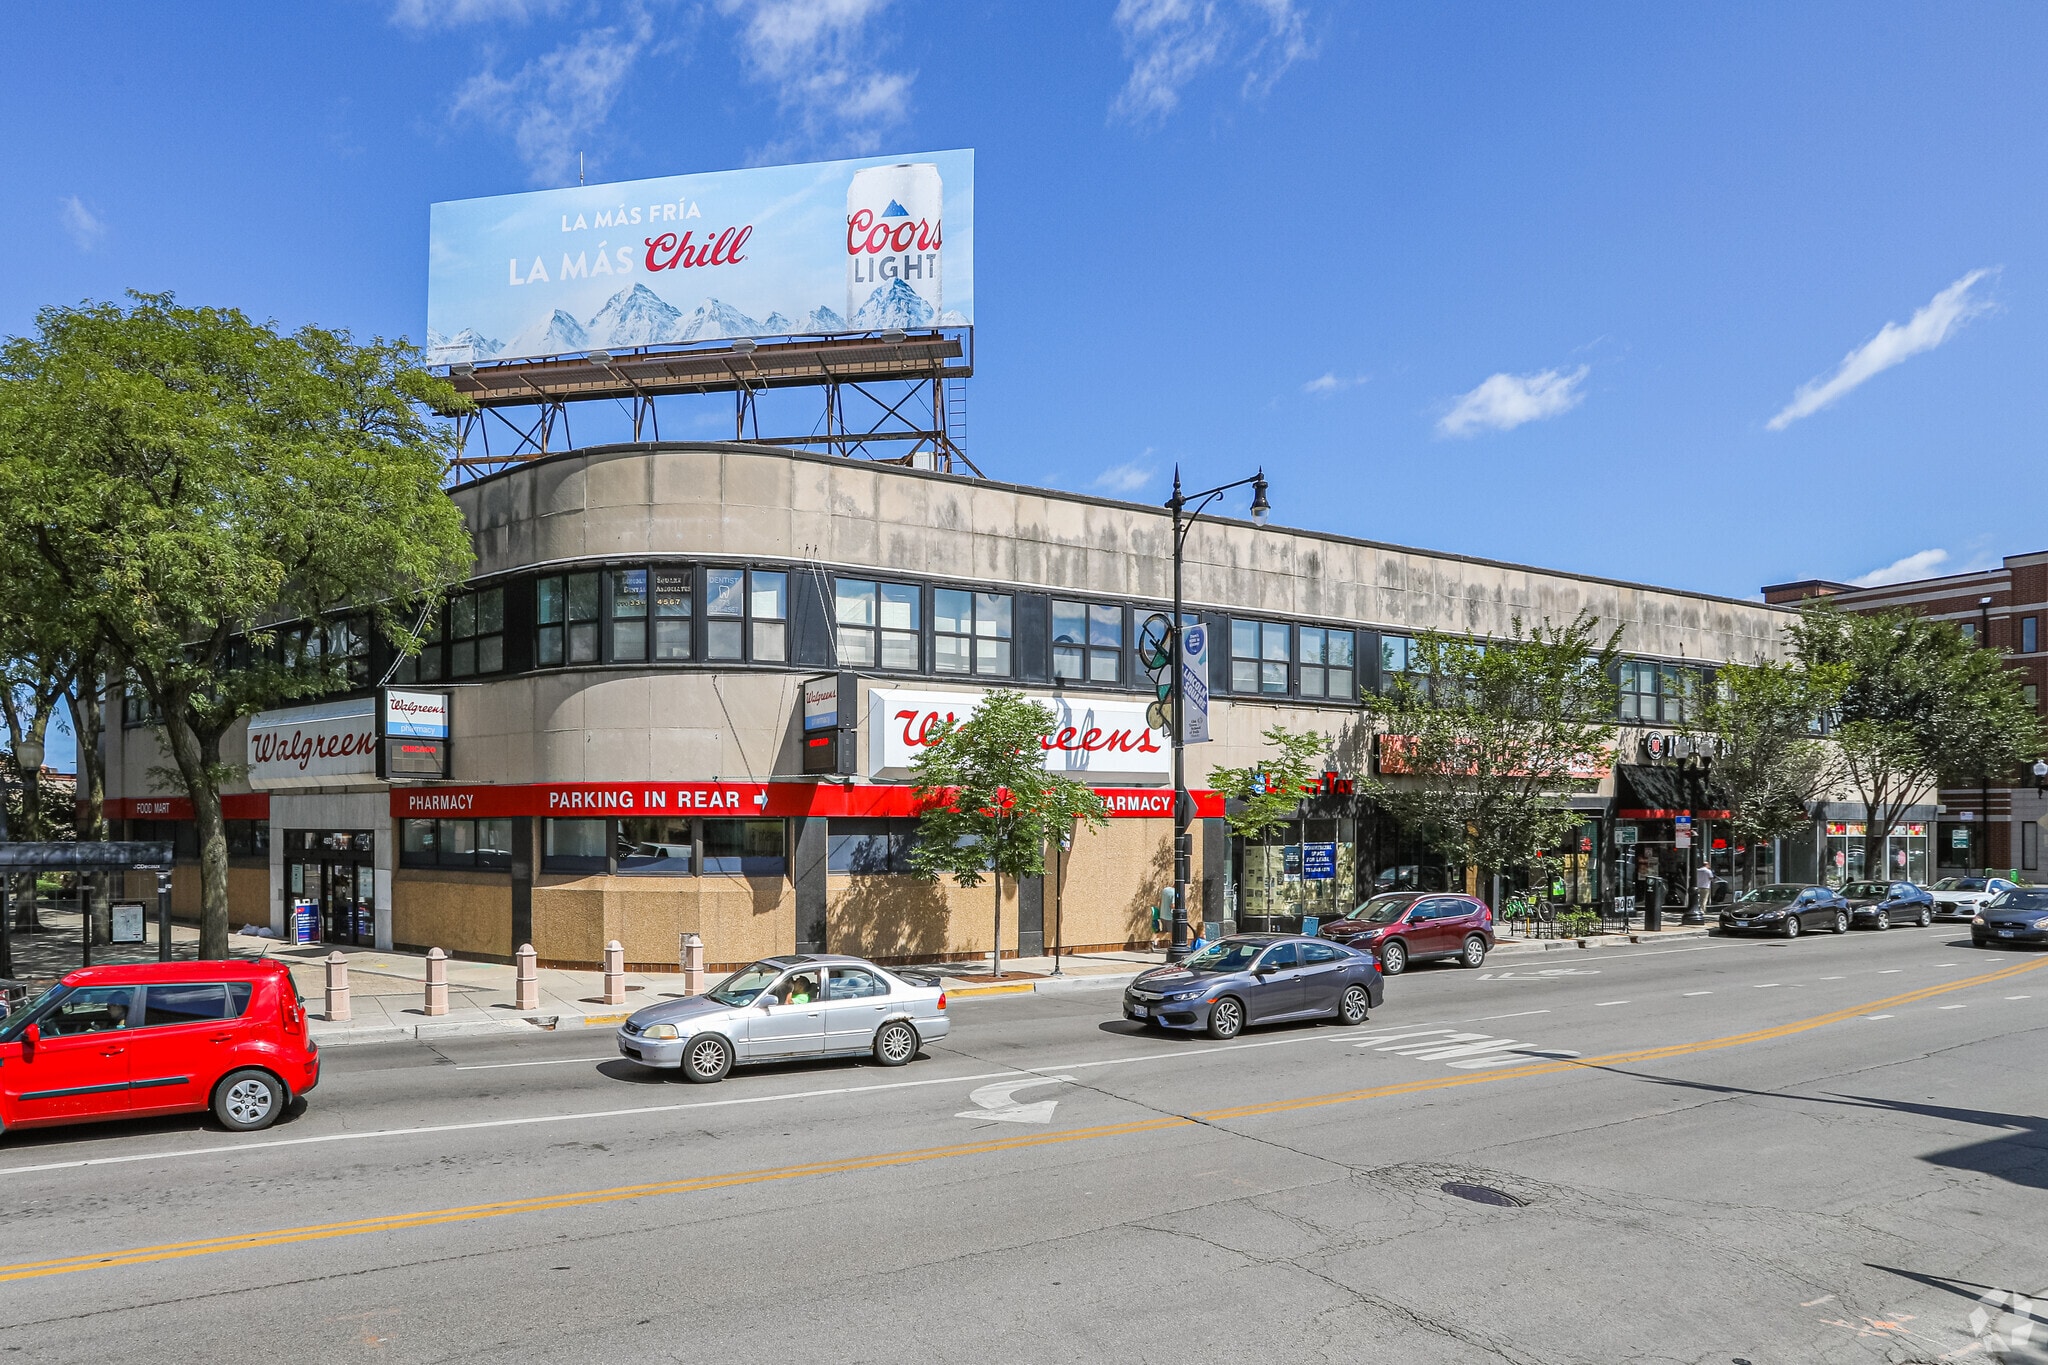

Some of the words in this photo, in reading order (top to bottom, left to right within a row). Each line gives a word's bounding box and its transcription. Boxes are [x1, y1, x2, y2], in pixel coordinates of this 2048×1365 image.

[561, 213, 588, 232] LA
[594, 203, 642, 228] MÁS
[649, 197, 702, 223] FRÍA
[847, 208, 942, 255] Coors
[509, 256, 550, 286] LA
[560, 240, 634, 281] MÁS
[644, 225, 753, 272] Chill
[855, 254, 937, 282] LIGHT
[806, 689, 837, 705] Walgreens
[1183, 668, 1207, 698] LINCOLN
[1183, 681, 1207, 709] SQUARE
[390, 699, 446, 715] Walgreens
[400, 724, 436, 735] pharmacy
[894, 709, 1161, 753] Weens
[252, 730, 376, 770] Walgreen
[137, 803, 152, 813] FOOD
[154, 803, 170, 813] MART
[409, 794, 474, 810] PHARMACY
[550, 791, 634, 808] PARKING
[644, 791, 666, 808] IN
[677, 791, 740, 808] REAR
